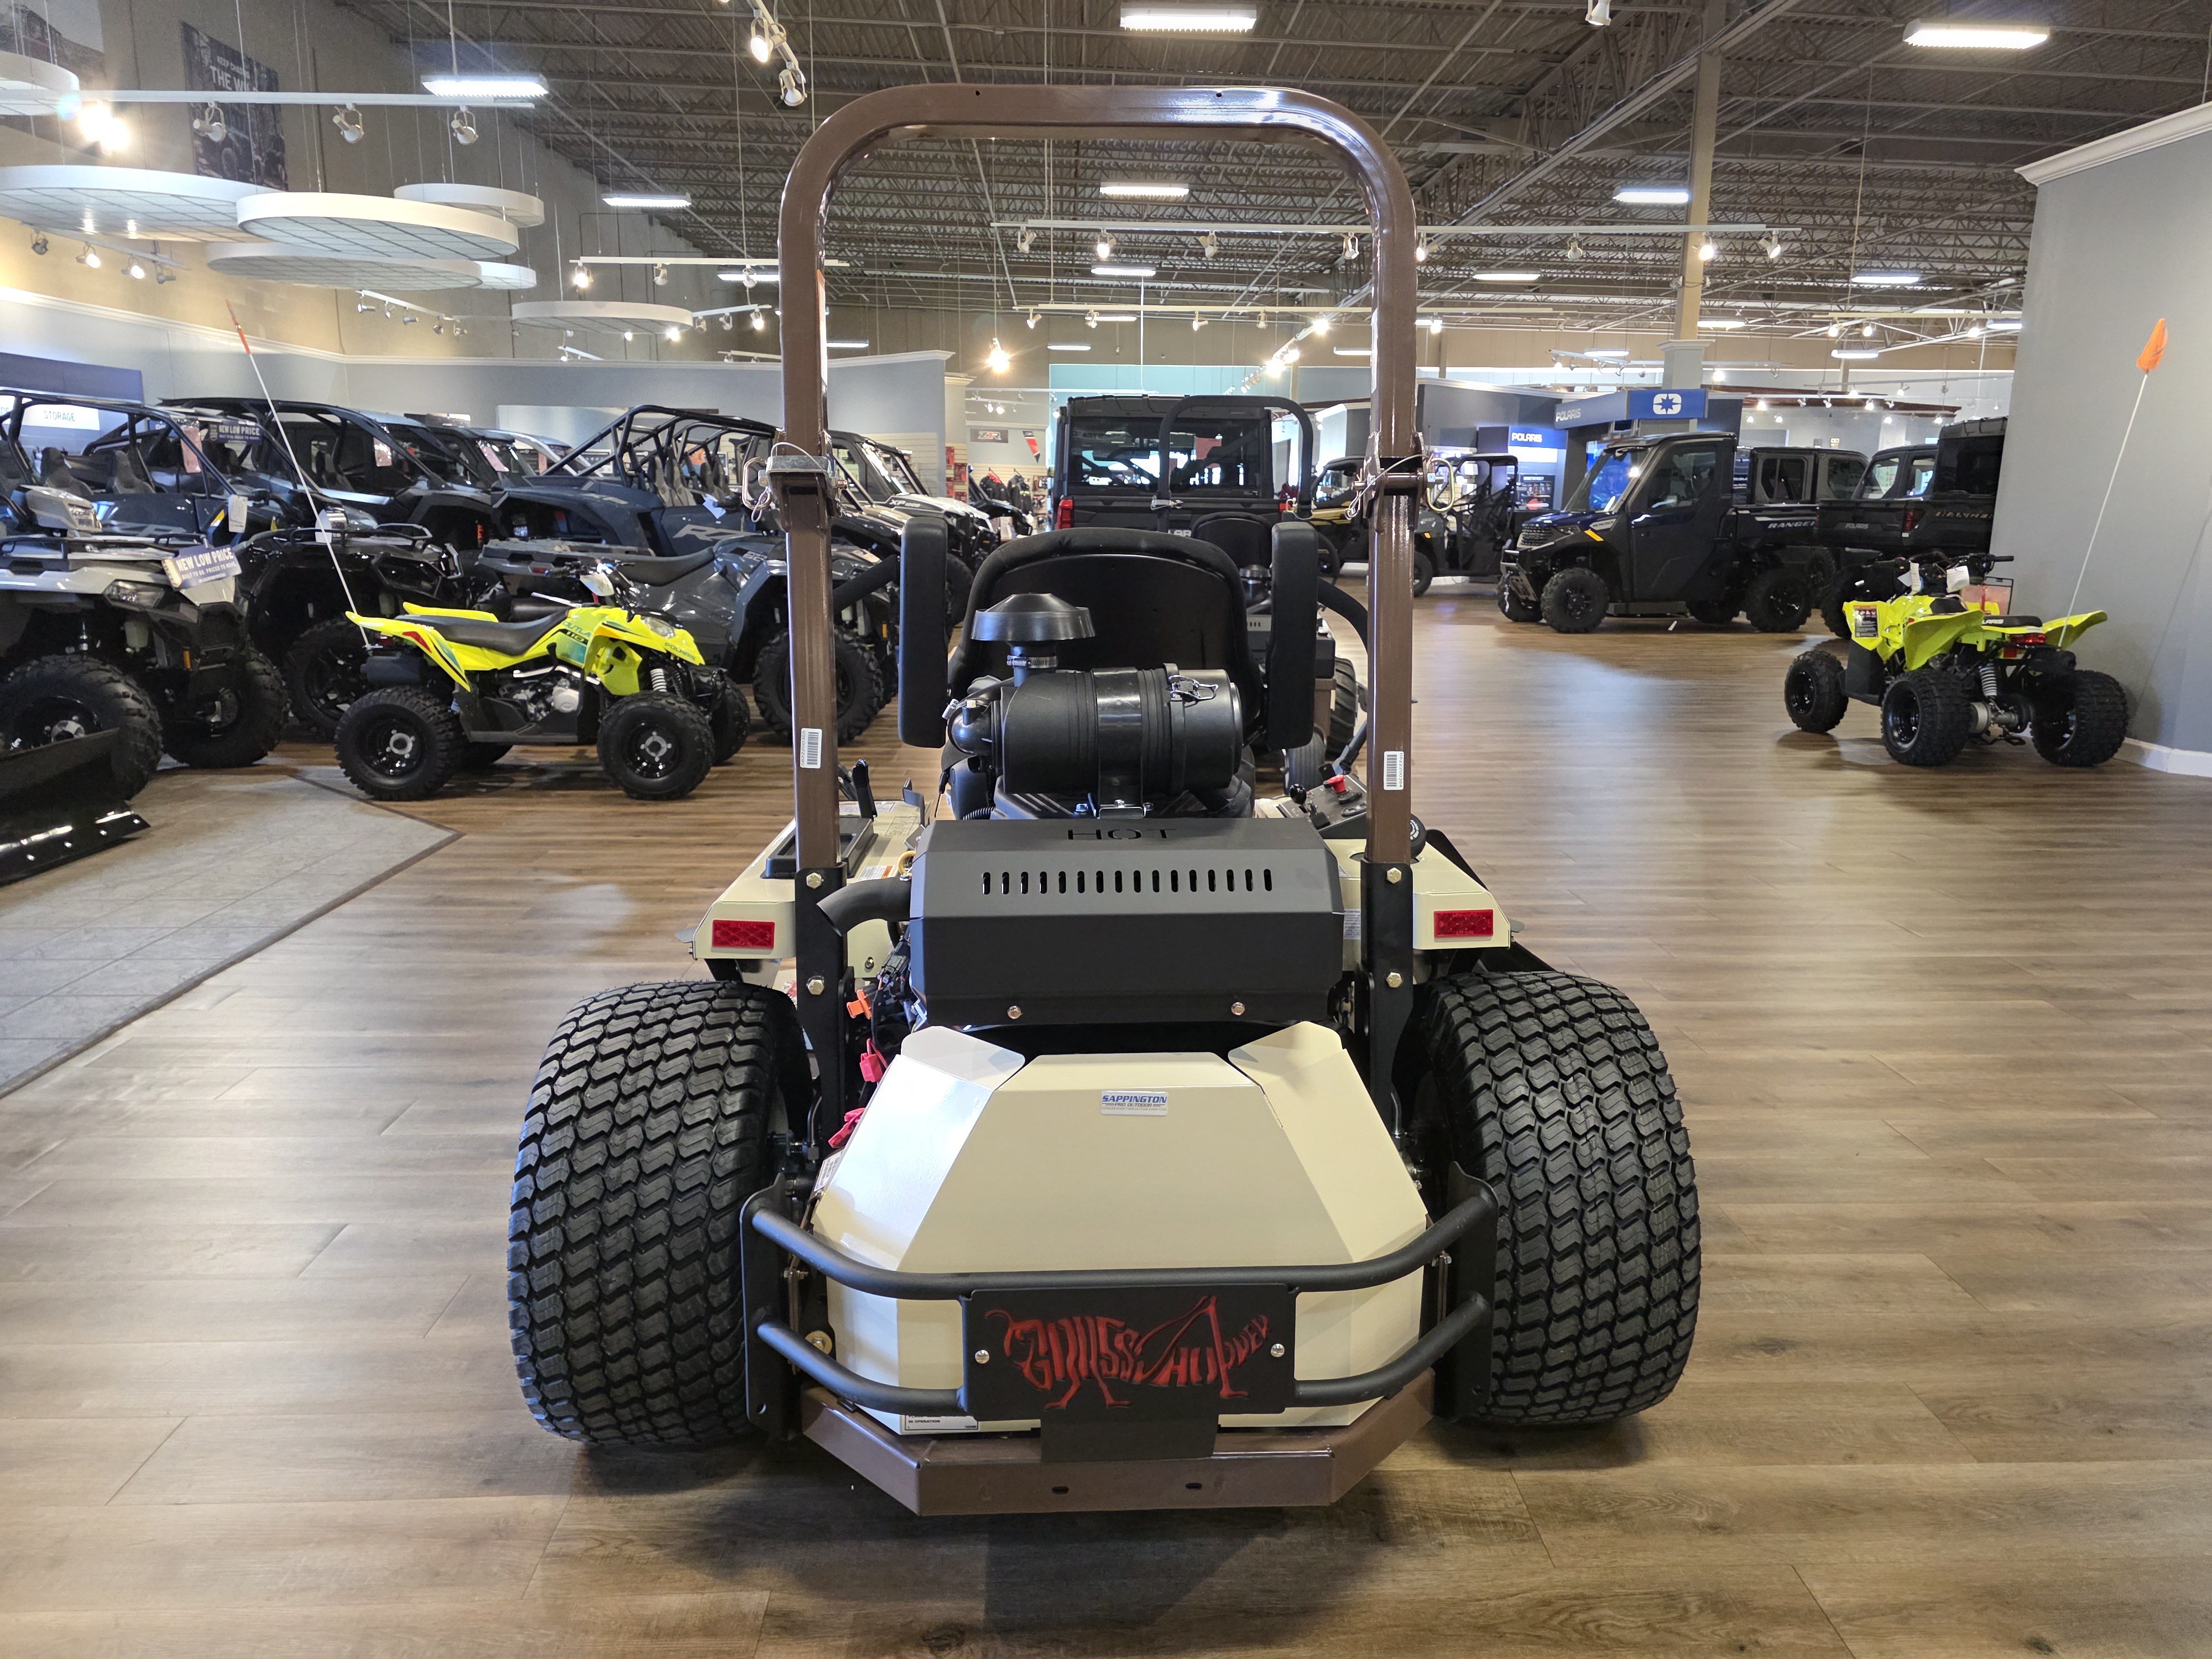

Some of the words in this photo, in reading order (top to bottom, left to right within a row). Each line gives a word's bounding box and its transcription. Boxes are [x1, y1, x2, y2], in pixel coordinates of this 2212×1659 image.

[210, 65, 232, 90] THE
[44, 411, 75, 421] STORAGE
[1555, 408, 1581, 422] POLARIS
[241, 426, 260, 435] PRICE
[1511, 432, 1542, 442] POLARIS
[176, 556, 194, 572] NEW
[194, 552, 212, 567] LOW
[211, 547, 234, 563] PRICE
[562, 621, 592, 637] OUTLA
[566, 631, 585, 641] 110
[664, 642, 696, 661] POLARIS
[1068, 828, 1177, 840] HOT
[1102, 1095, 1167, 1103] SAPPINGTON
